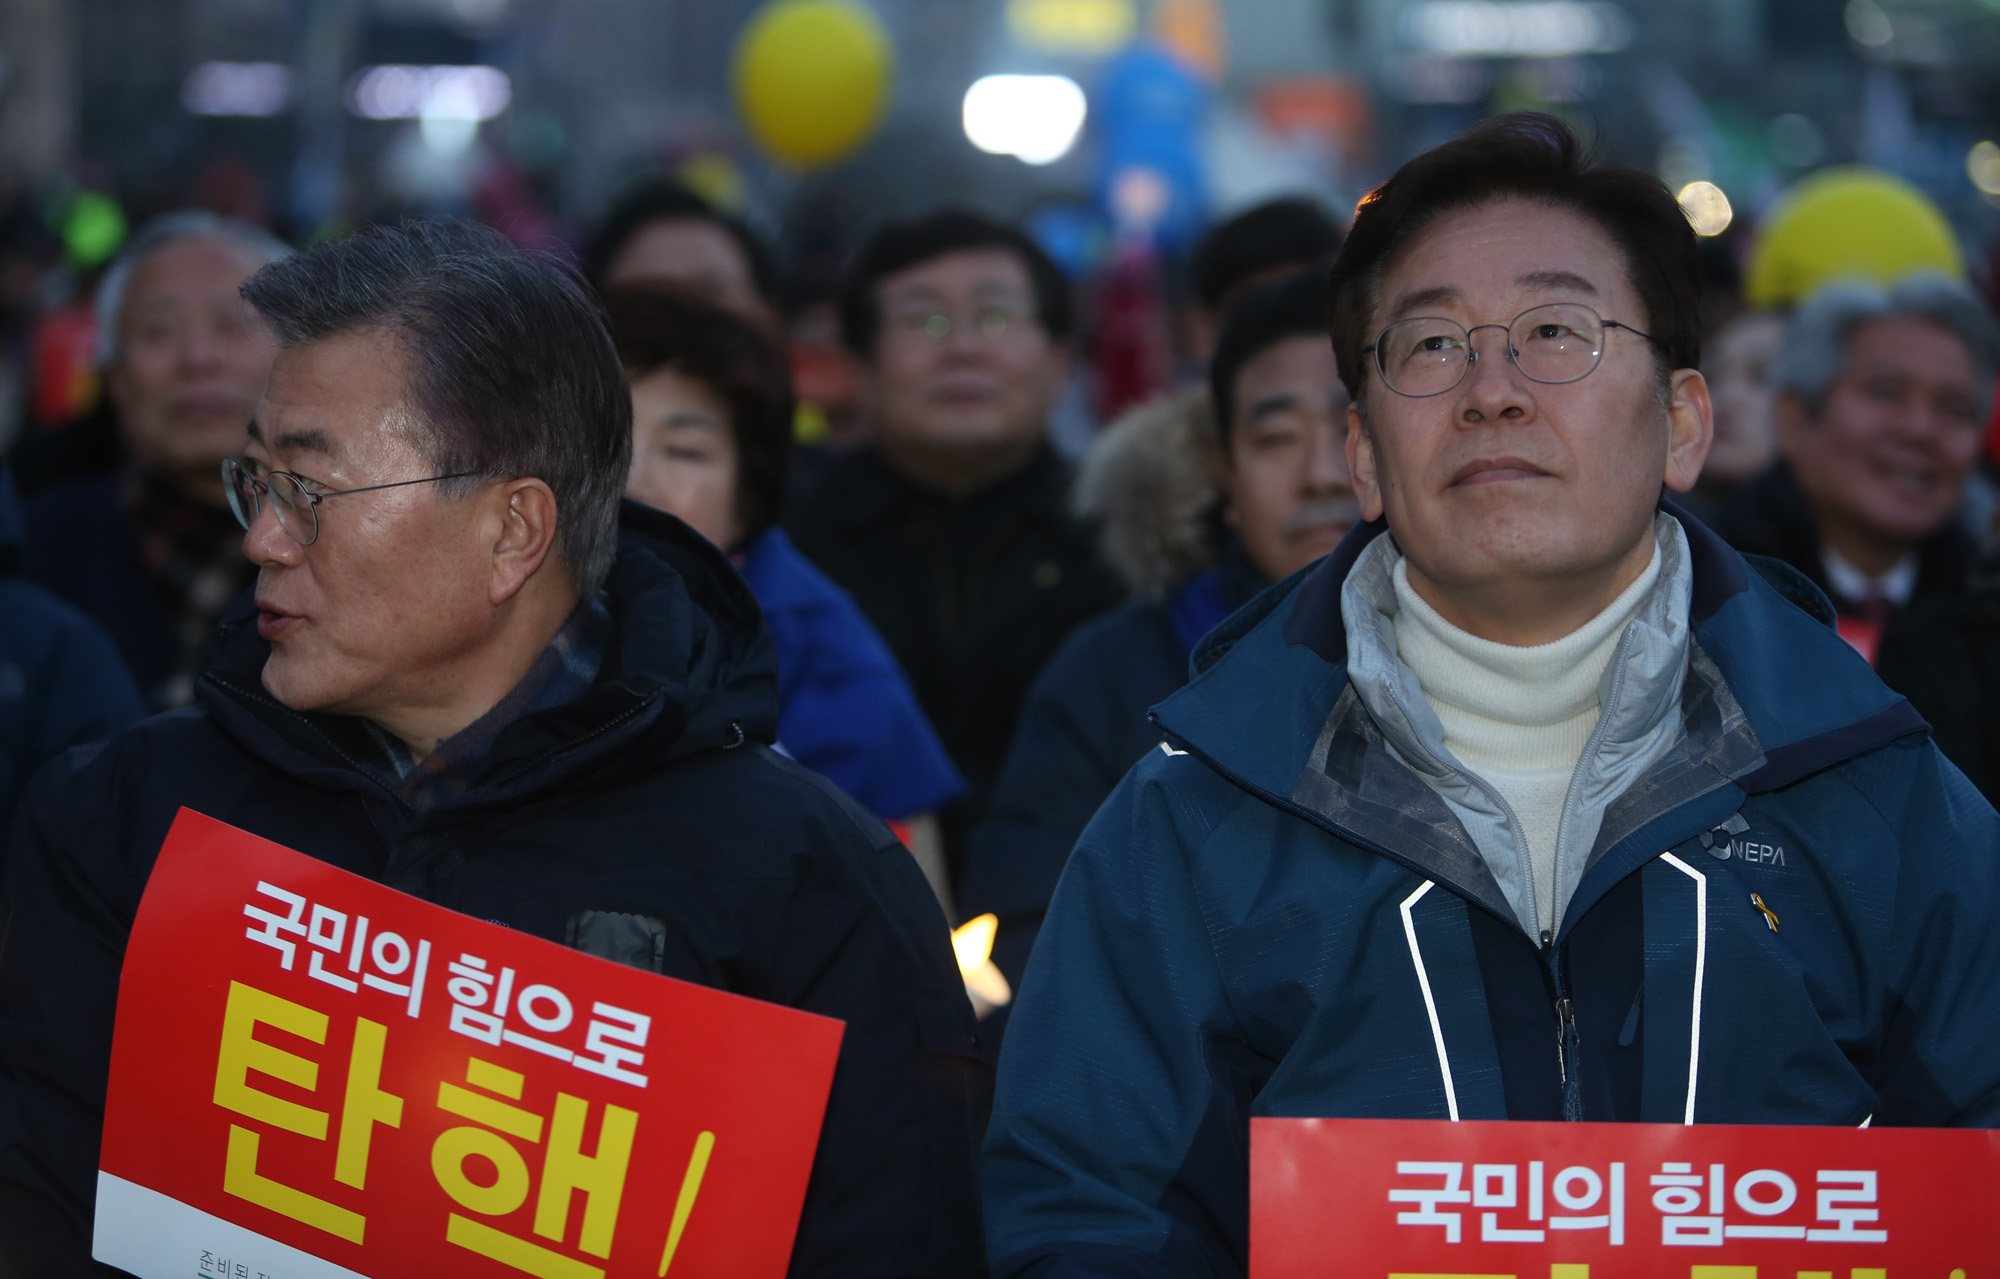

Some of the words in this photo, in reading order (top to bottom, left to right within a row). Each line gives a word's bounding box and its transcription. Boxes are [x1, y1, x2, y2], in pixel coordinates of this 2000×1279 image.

[1731, 838, 1786, 867] NEPA
[243, 880, 432, 1019] 국민의
[447, 953, 652, 1088] 힘으로
[1387, 1160, 1626, 1246] 국민의
[1649, 1161, 1888, 1247] 힘으로
